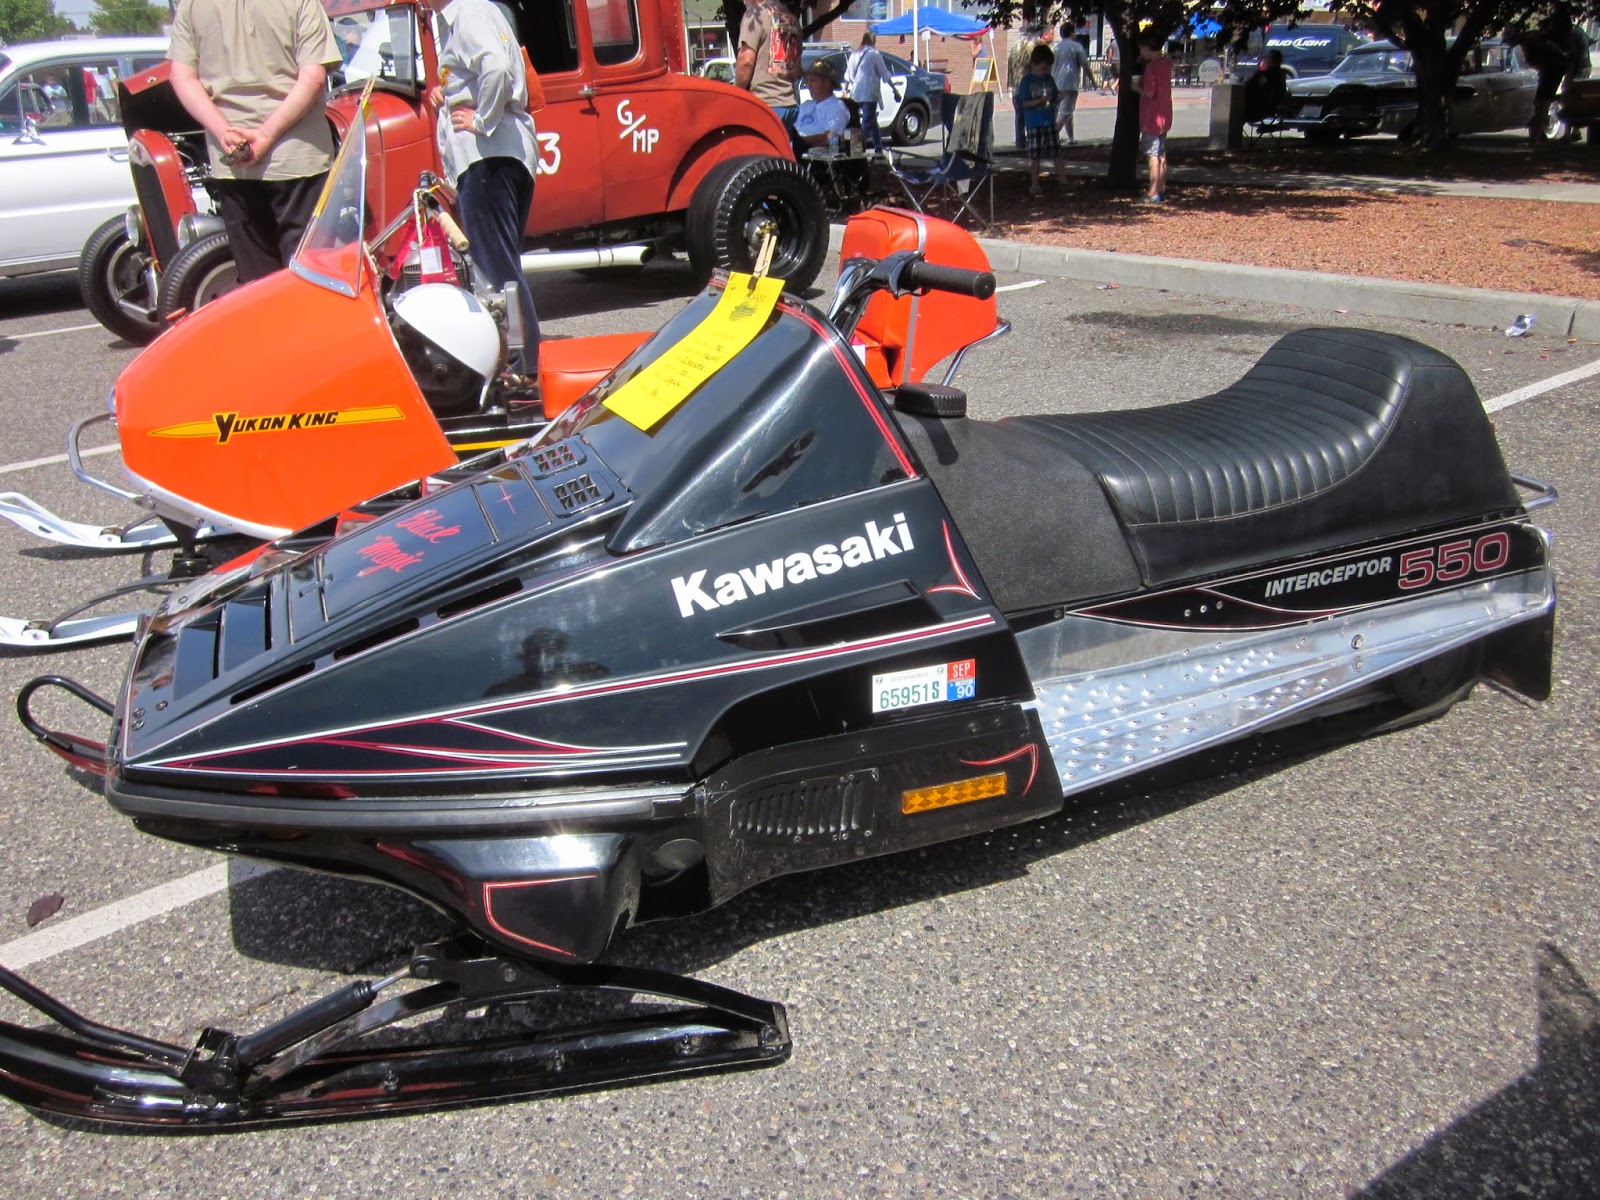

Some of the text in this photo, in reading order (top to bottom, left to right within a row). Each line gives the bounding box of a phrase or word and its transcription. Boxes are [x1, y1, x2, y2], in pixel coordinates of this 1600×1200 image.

[1265, 38, 1331, 47] BUD LIGHT
[536, 132, 562, 175] 3
[287, 411, 340, 430] KING
[396, 508, 462, 544] Black
[356, 535, 425, 578] Magic
[670, 512, 915, 618] Kawasaki
[1264, 532, 1510, 598] INTERCEPTOR 550
[952, 661, 971, 679] SEP
[880, 680, 940, 710] 65951S
[956, 684, 974, 699] 90
